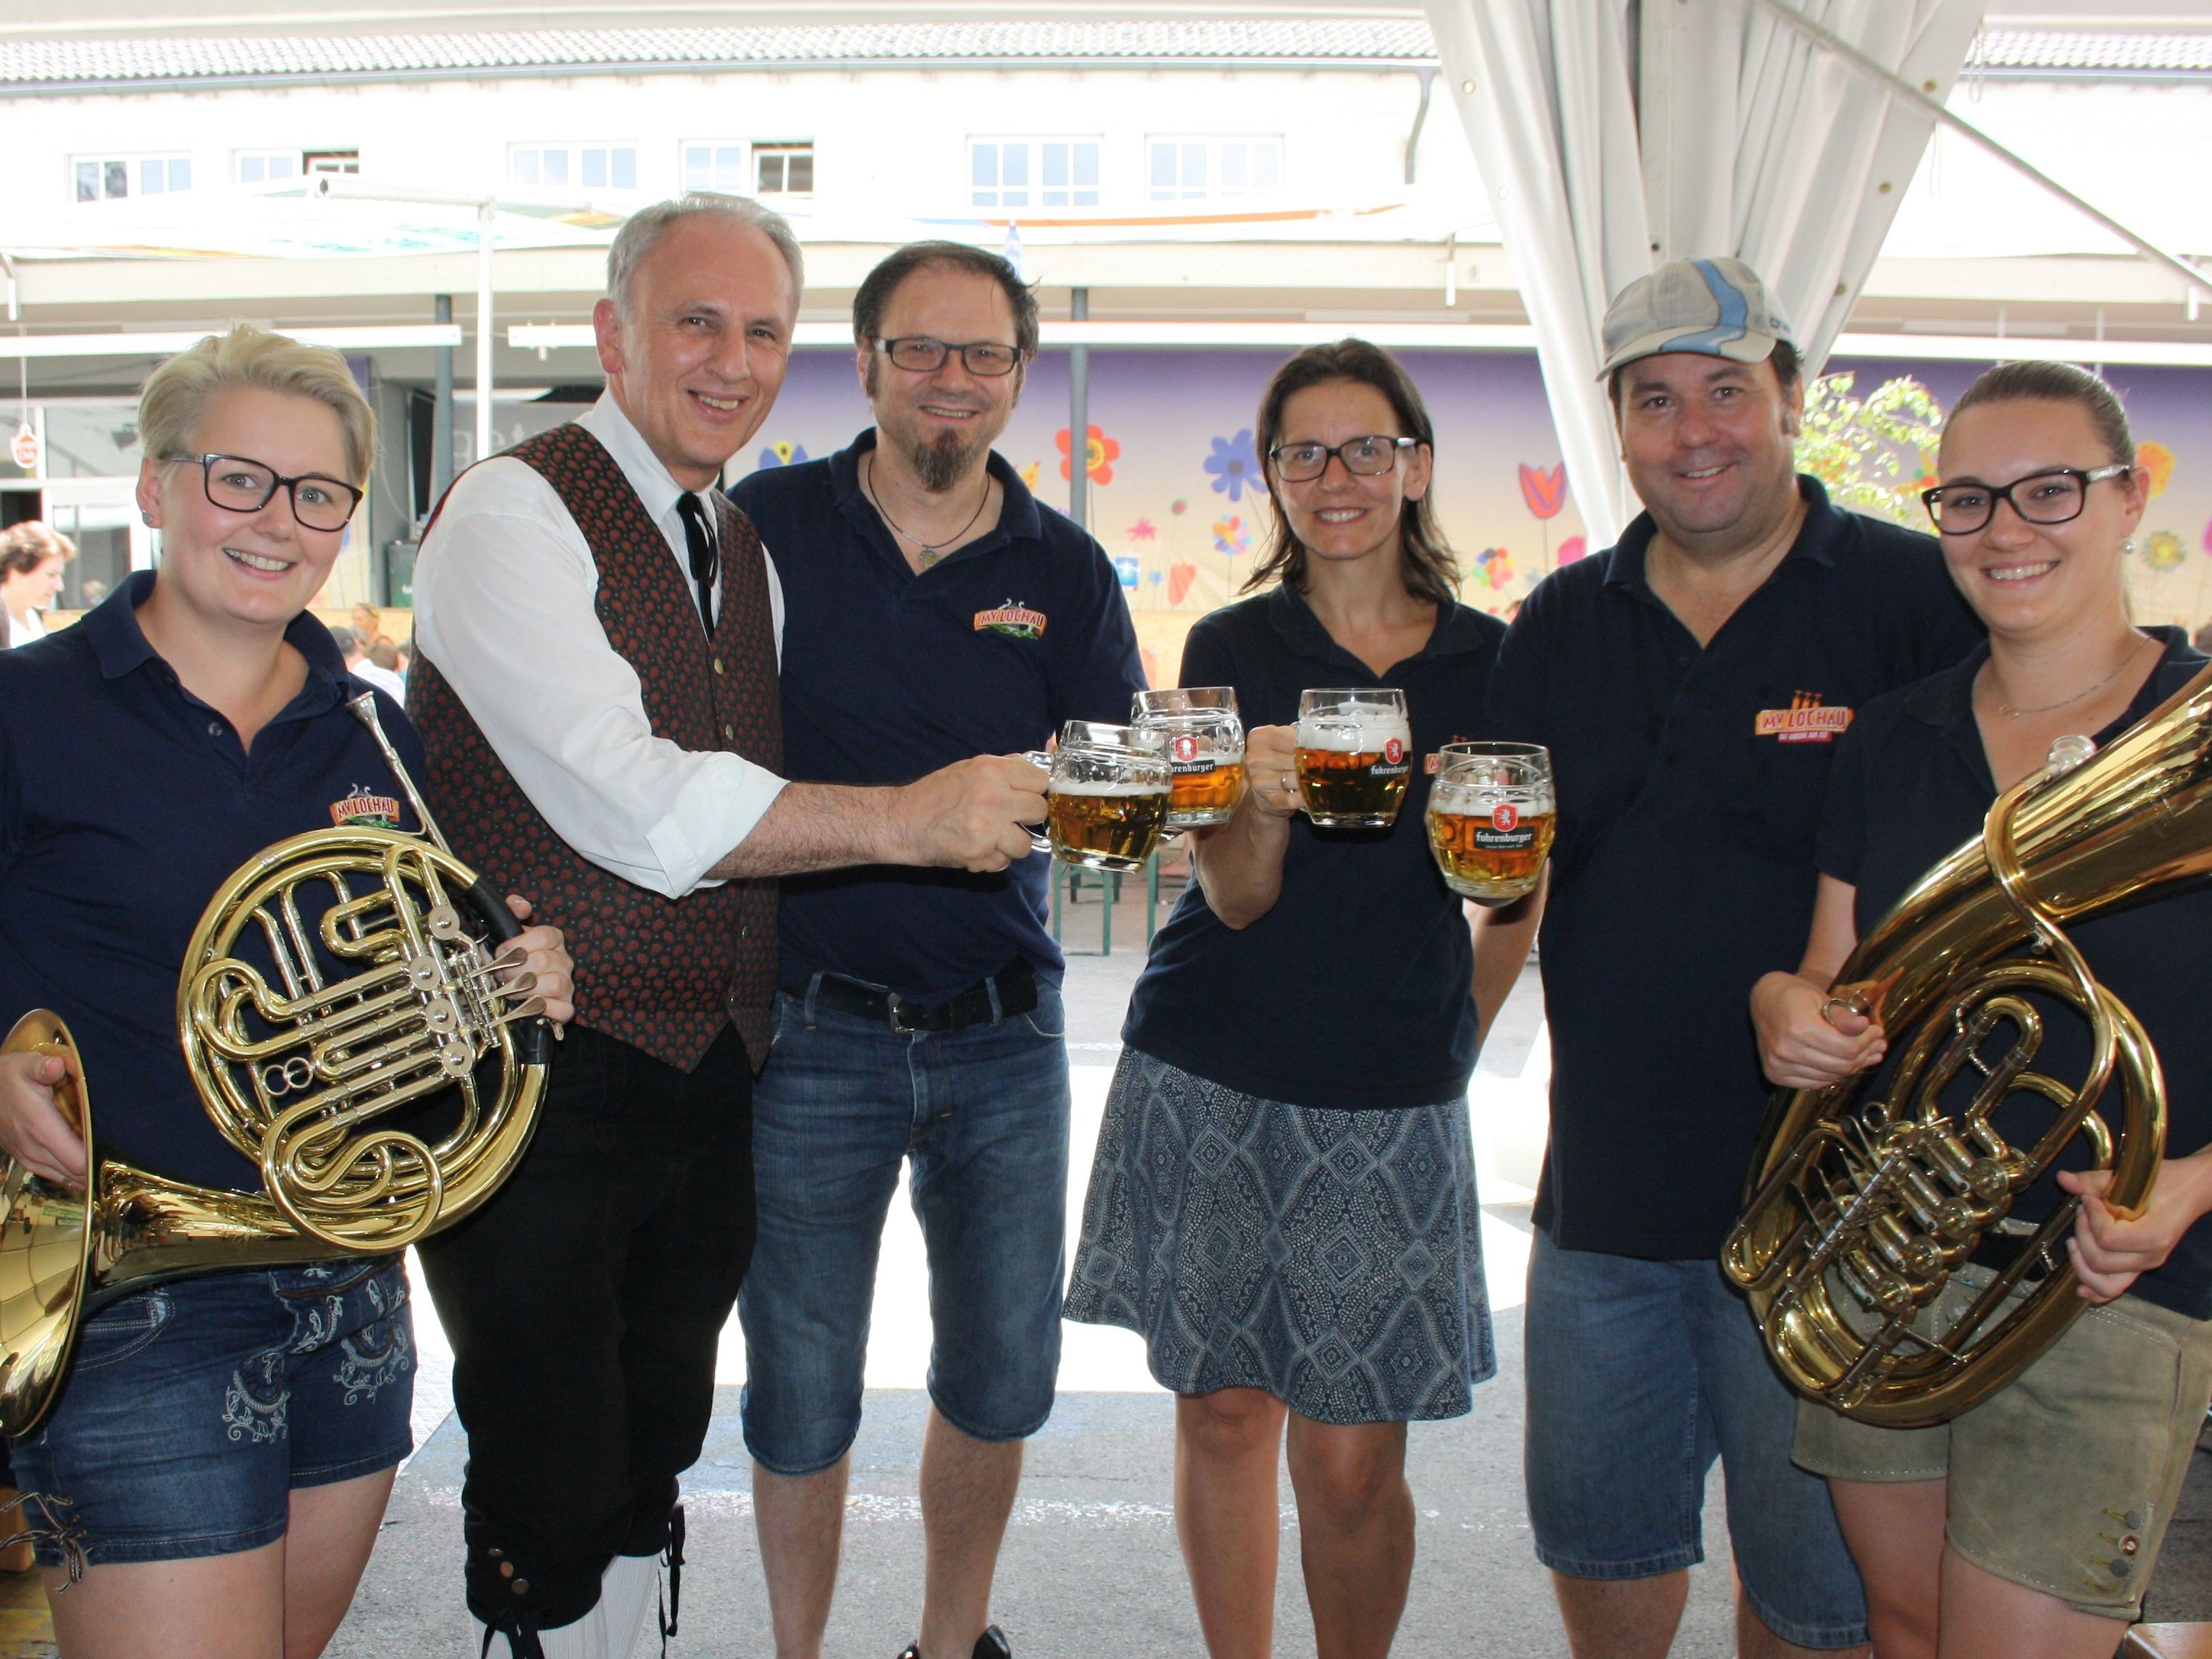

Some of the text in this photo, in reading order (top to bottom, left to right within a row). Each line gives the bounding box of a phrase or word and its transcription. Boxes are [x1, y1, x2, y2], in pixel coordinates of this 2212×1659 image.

[1000, 610, 1044, 627] LOCHAU
[1788, 710, 1846, 728] LOCHAU
[352, 798, 394, 815] LOCHAU
